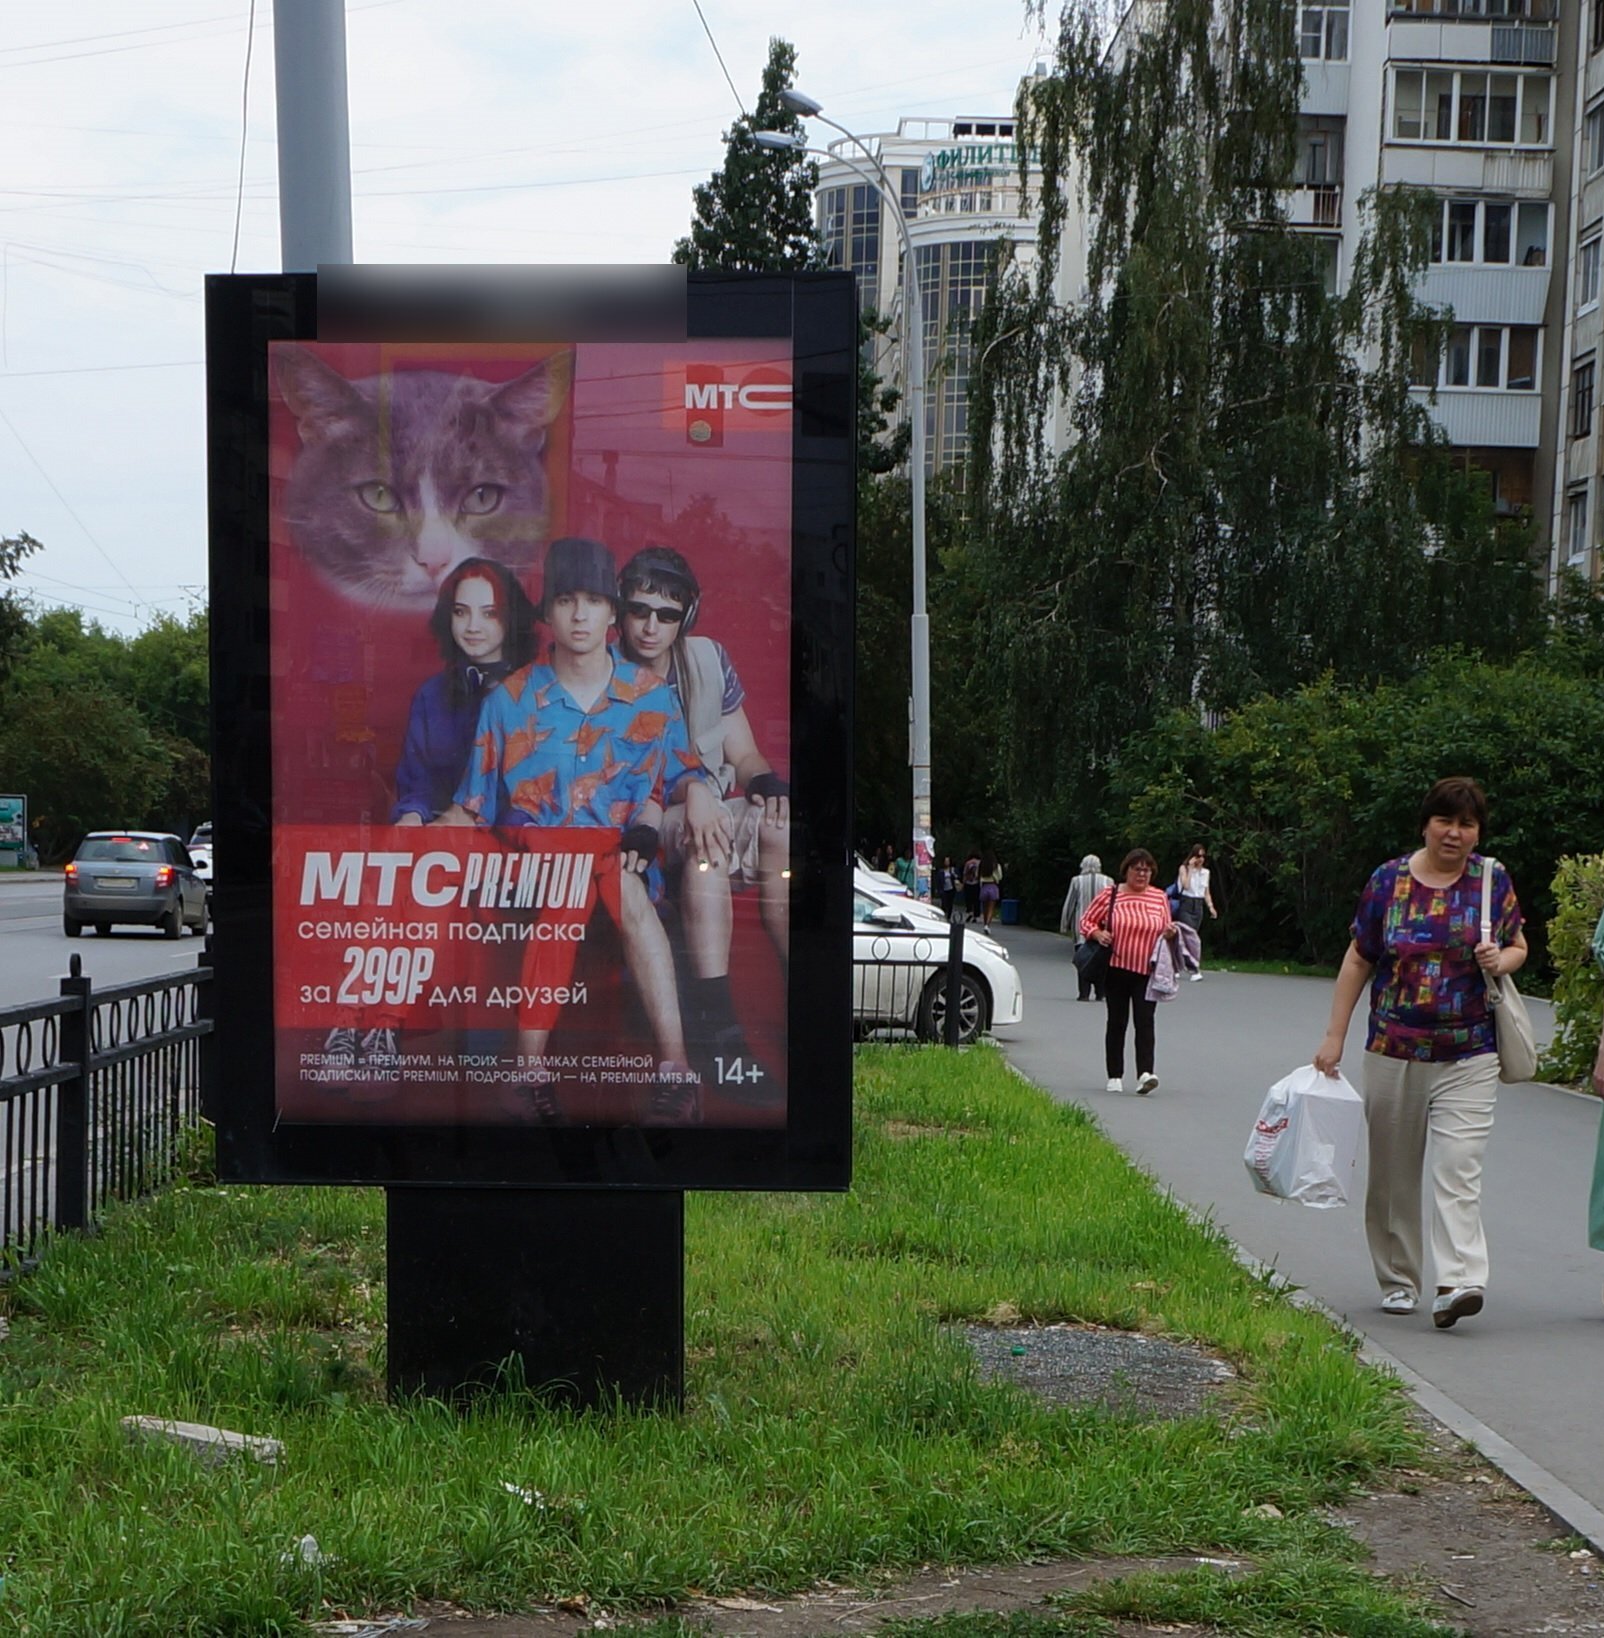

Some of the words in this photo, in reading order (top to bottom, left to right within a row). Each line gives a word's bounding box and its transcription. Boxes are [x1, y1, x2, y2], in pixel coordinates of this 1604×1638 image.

[685, 383, 793, 410] МТС
[298, 917, 439, 940] семейная
[448, 922, 586, 944] подписка
[299, 985, 331, 1004] за
[428, 985, 477, 1007] для
[485, 982, 588, 1009] друзей
[299, 1053, 355, 1066] PREMIUM
[437, 1055, 455, 1067] НА
[458, 1055, 498, 1067] ТРОИХ
[517, 1056, 525, 1067] В
[527, 1056, 578, 1068] РАМКАХ
[581, 1054, 654, 1068] СЕМЕЙНОЙ
[713, 1056, 765, 1085] 14+
[299, 1069, 371, 1082] ПОДПИСКИ
[374, 1070, 400, 1082] МТС
[465, 1071, 561, 1084] ПОДРОБНОСТИ
[580, 1072, 597, 1084] НА
[600, 1072, 702, 1085] PREMIUM.MTS.RU
